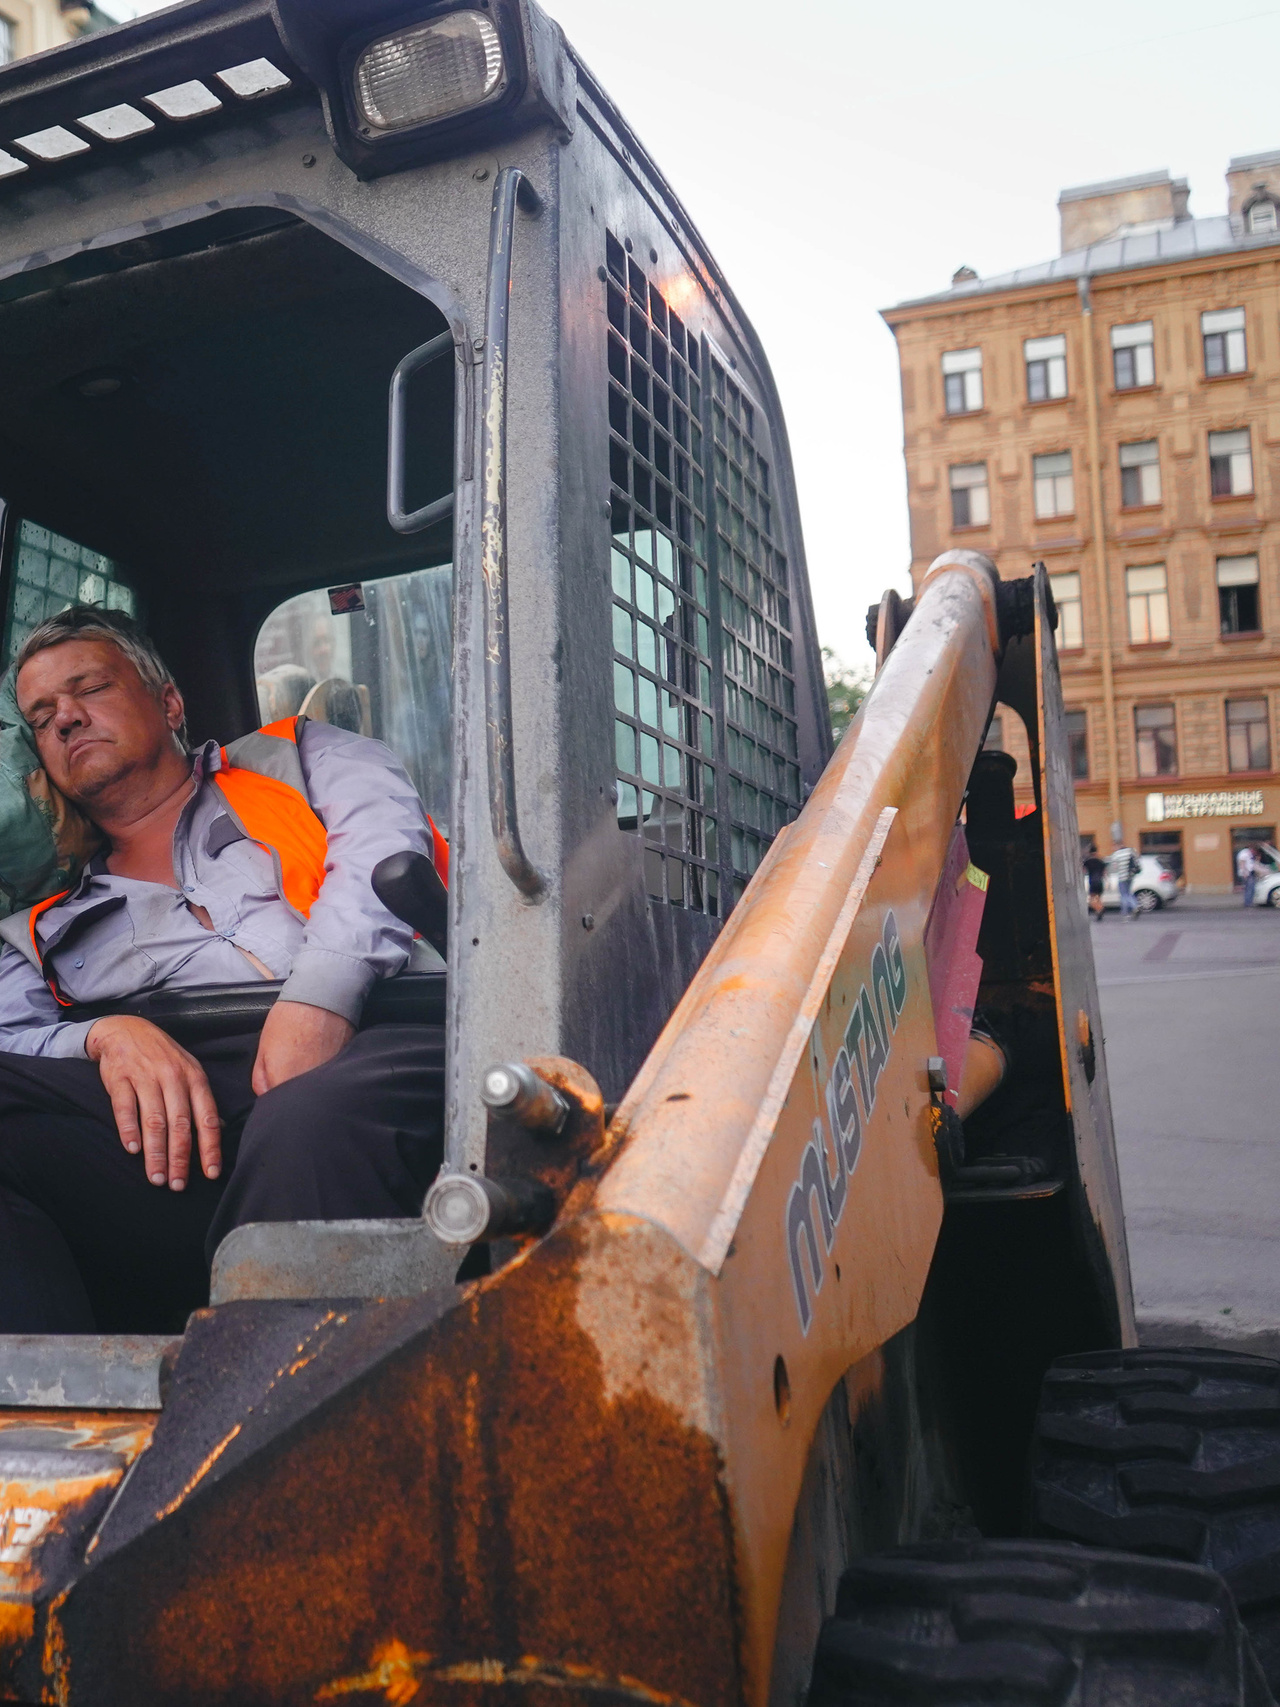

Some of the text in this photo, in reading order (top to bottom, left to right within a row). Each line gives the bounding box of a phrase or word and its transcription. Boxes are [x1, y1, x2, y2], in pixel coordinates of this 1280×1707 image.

[1165, 790, 1263, 804] МУЗЫКАЛЬНЫЕ
[1165, 801, 1264, 819] ИНСТРУМЕНТЫ
[786, 908, 907, 1338] MUSTANG
